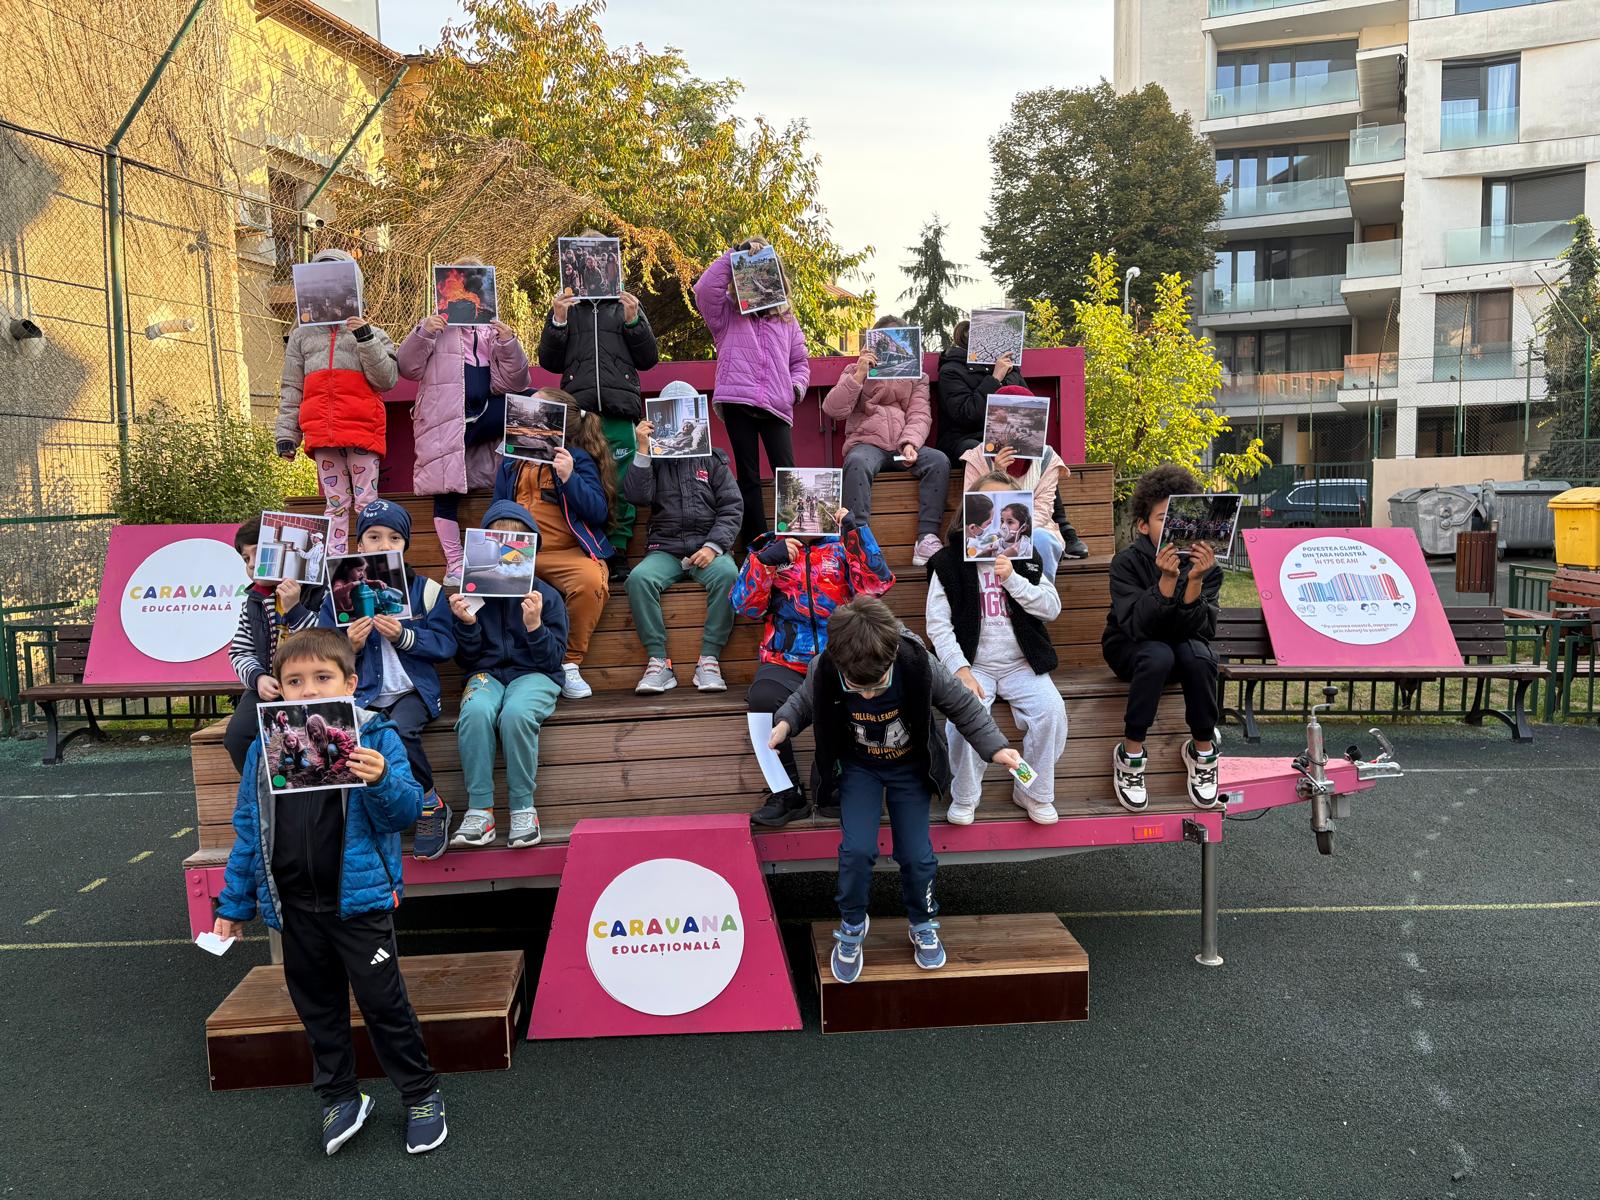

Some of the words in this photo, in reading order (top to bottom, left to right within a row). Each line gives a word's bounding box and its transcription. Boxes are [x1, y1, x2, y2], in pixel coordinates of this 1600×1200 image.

[129, 584, 248, 600] CARAVANA
[141, 601, 232, 614] EDUCAȚIONALĂ
[852, 712, 877, 722] COLLEGE
[877, 709, 899, 722] LEAGUE
[851, 717, 911, 748] LA
[593, 914, 738, 939] CARAVANA
[611, 938, 721, 955] EDUCAȚIONALĂ
